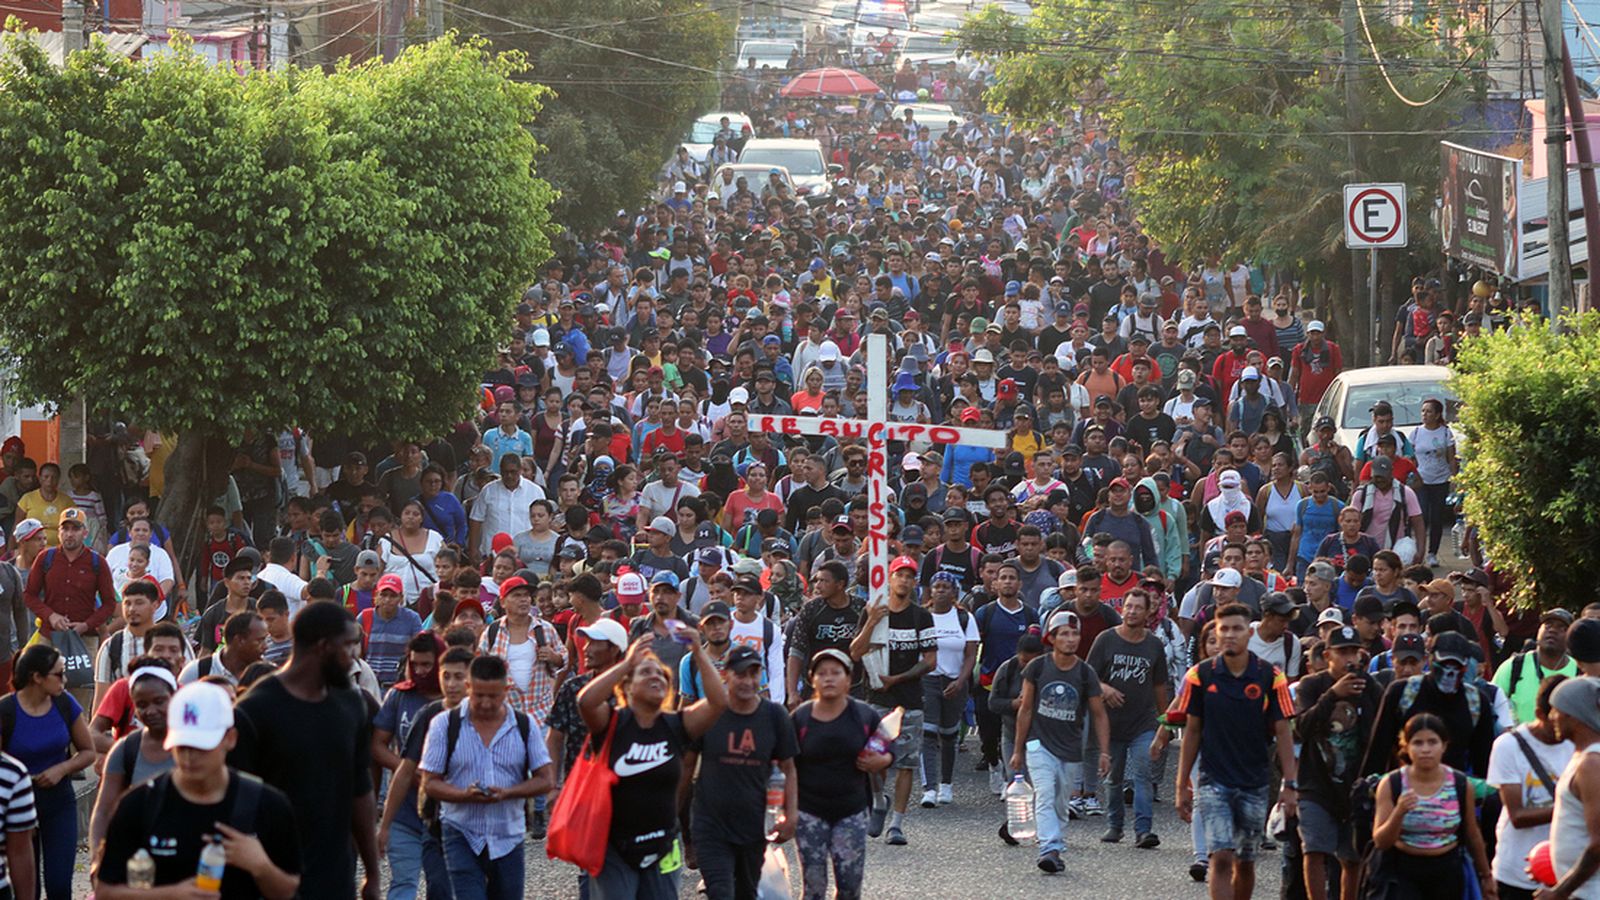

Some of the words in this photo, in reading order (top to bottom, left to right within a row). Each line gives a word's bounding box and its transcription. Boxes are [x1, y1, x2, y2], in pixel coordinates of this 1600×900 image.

[1362, 198, 1389, 233] E
[868, 422, 888, 590] CRISTO
[626, 741, 669, 761] NIKE
[728, 728, 757, 755] LA
